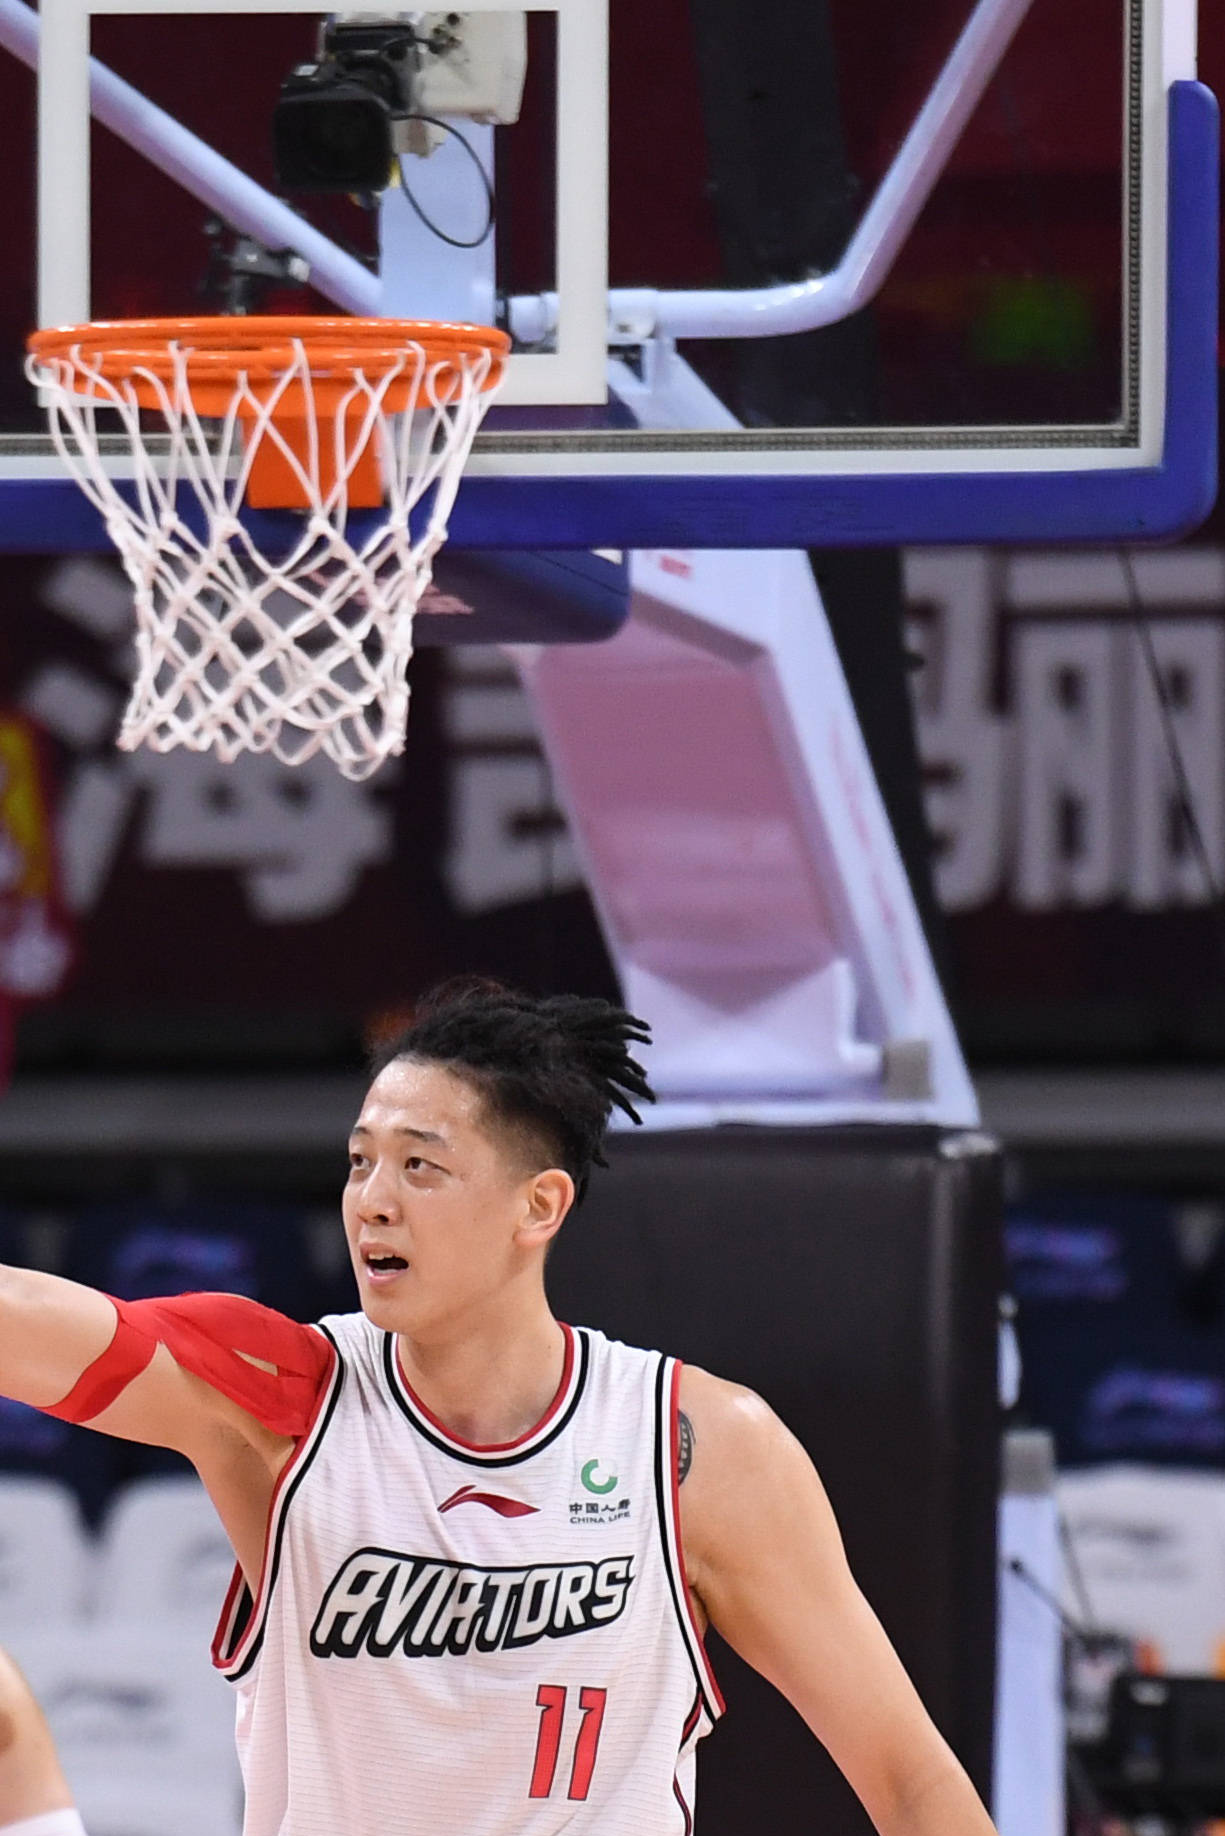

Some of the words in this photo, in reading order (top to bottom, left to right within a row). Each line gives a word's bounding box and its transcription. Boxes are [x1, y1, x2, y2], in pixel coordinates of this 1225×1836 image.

[569, 1516, 605, 1524] CHINA
[310, 1547, 634, 1659] AVIATORS
[528, 1684, 607, 1801] 11
